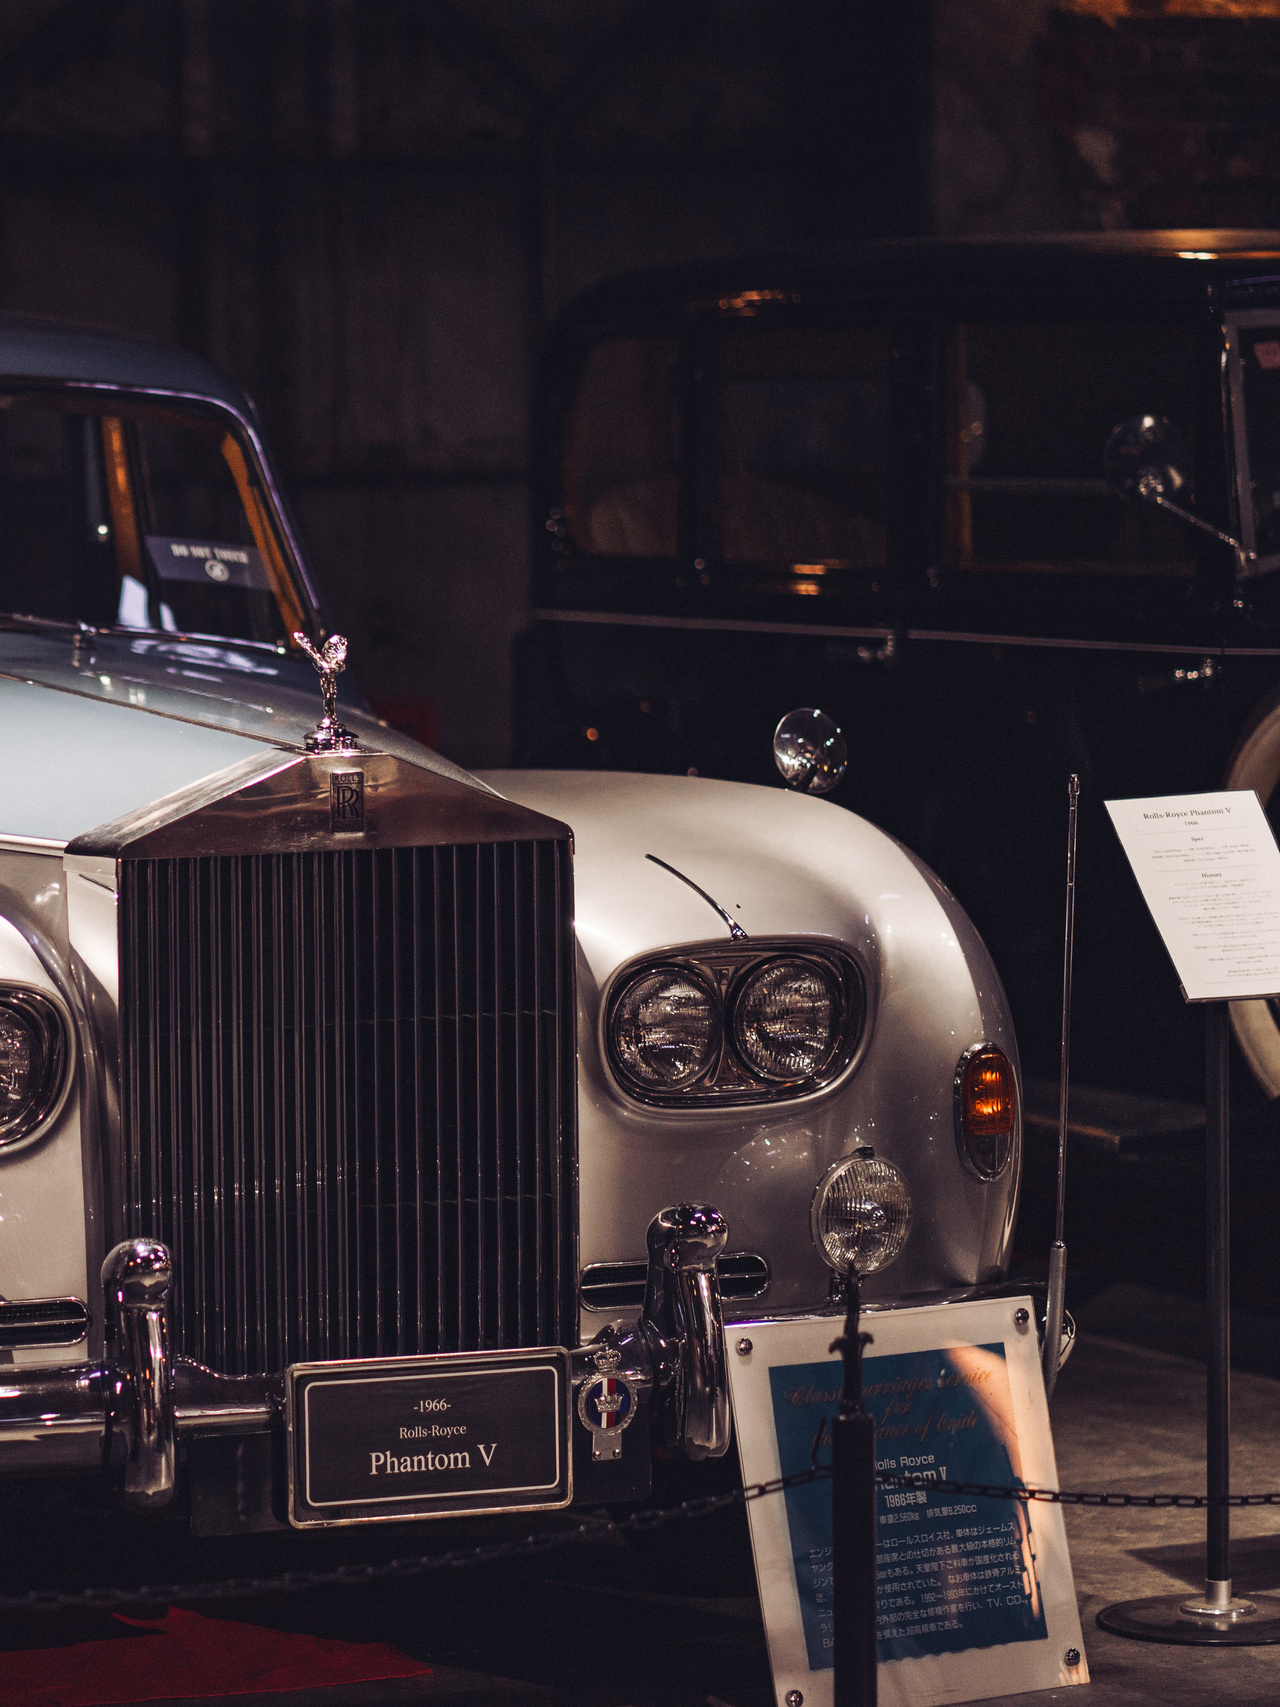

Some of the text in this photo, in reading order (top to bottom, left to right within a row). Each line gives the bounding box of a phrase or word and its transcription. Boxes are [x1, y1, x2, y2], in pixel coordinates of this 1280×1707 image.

[1143, 811, 1188, 820] Rolls-Royce
[1189, 808, 1224, 816] Phantom
[413, 1398, 452, 1412] -1966-
[399, 1424, 467, 1439] Rolls-Royce
[369, 1443, 498, 1475] Phantom V
[900, 1454, 935, 1467] Royce
[884, 1490, 928, 1508] 1966年製
